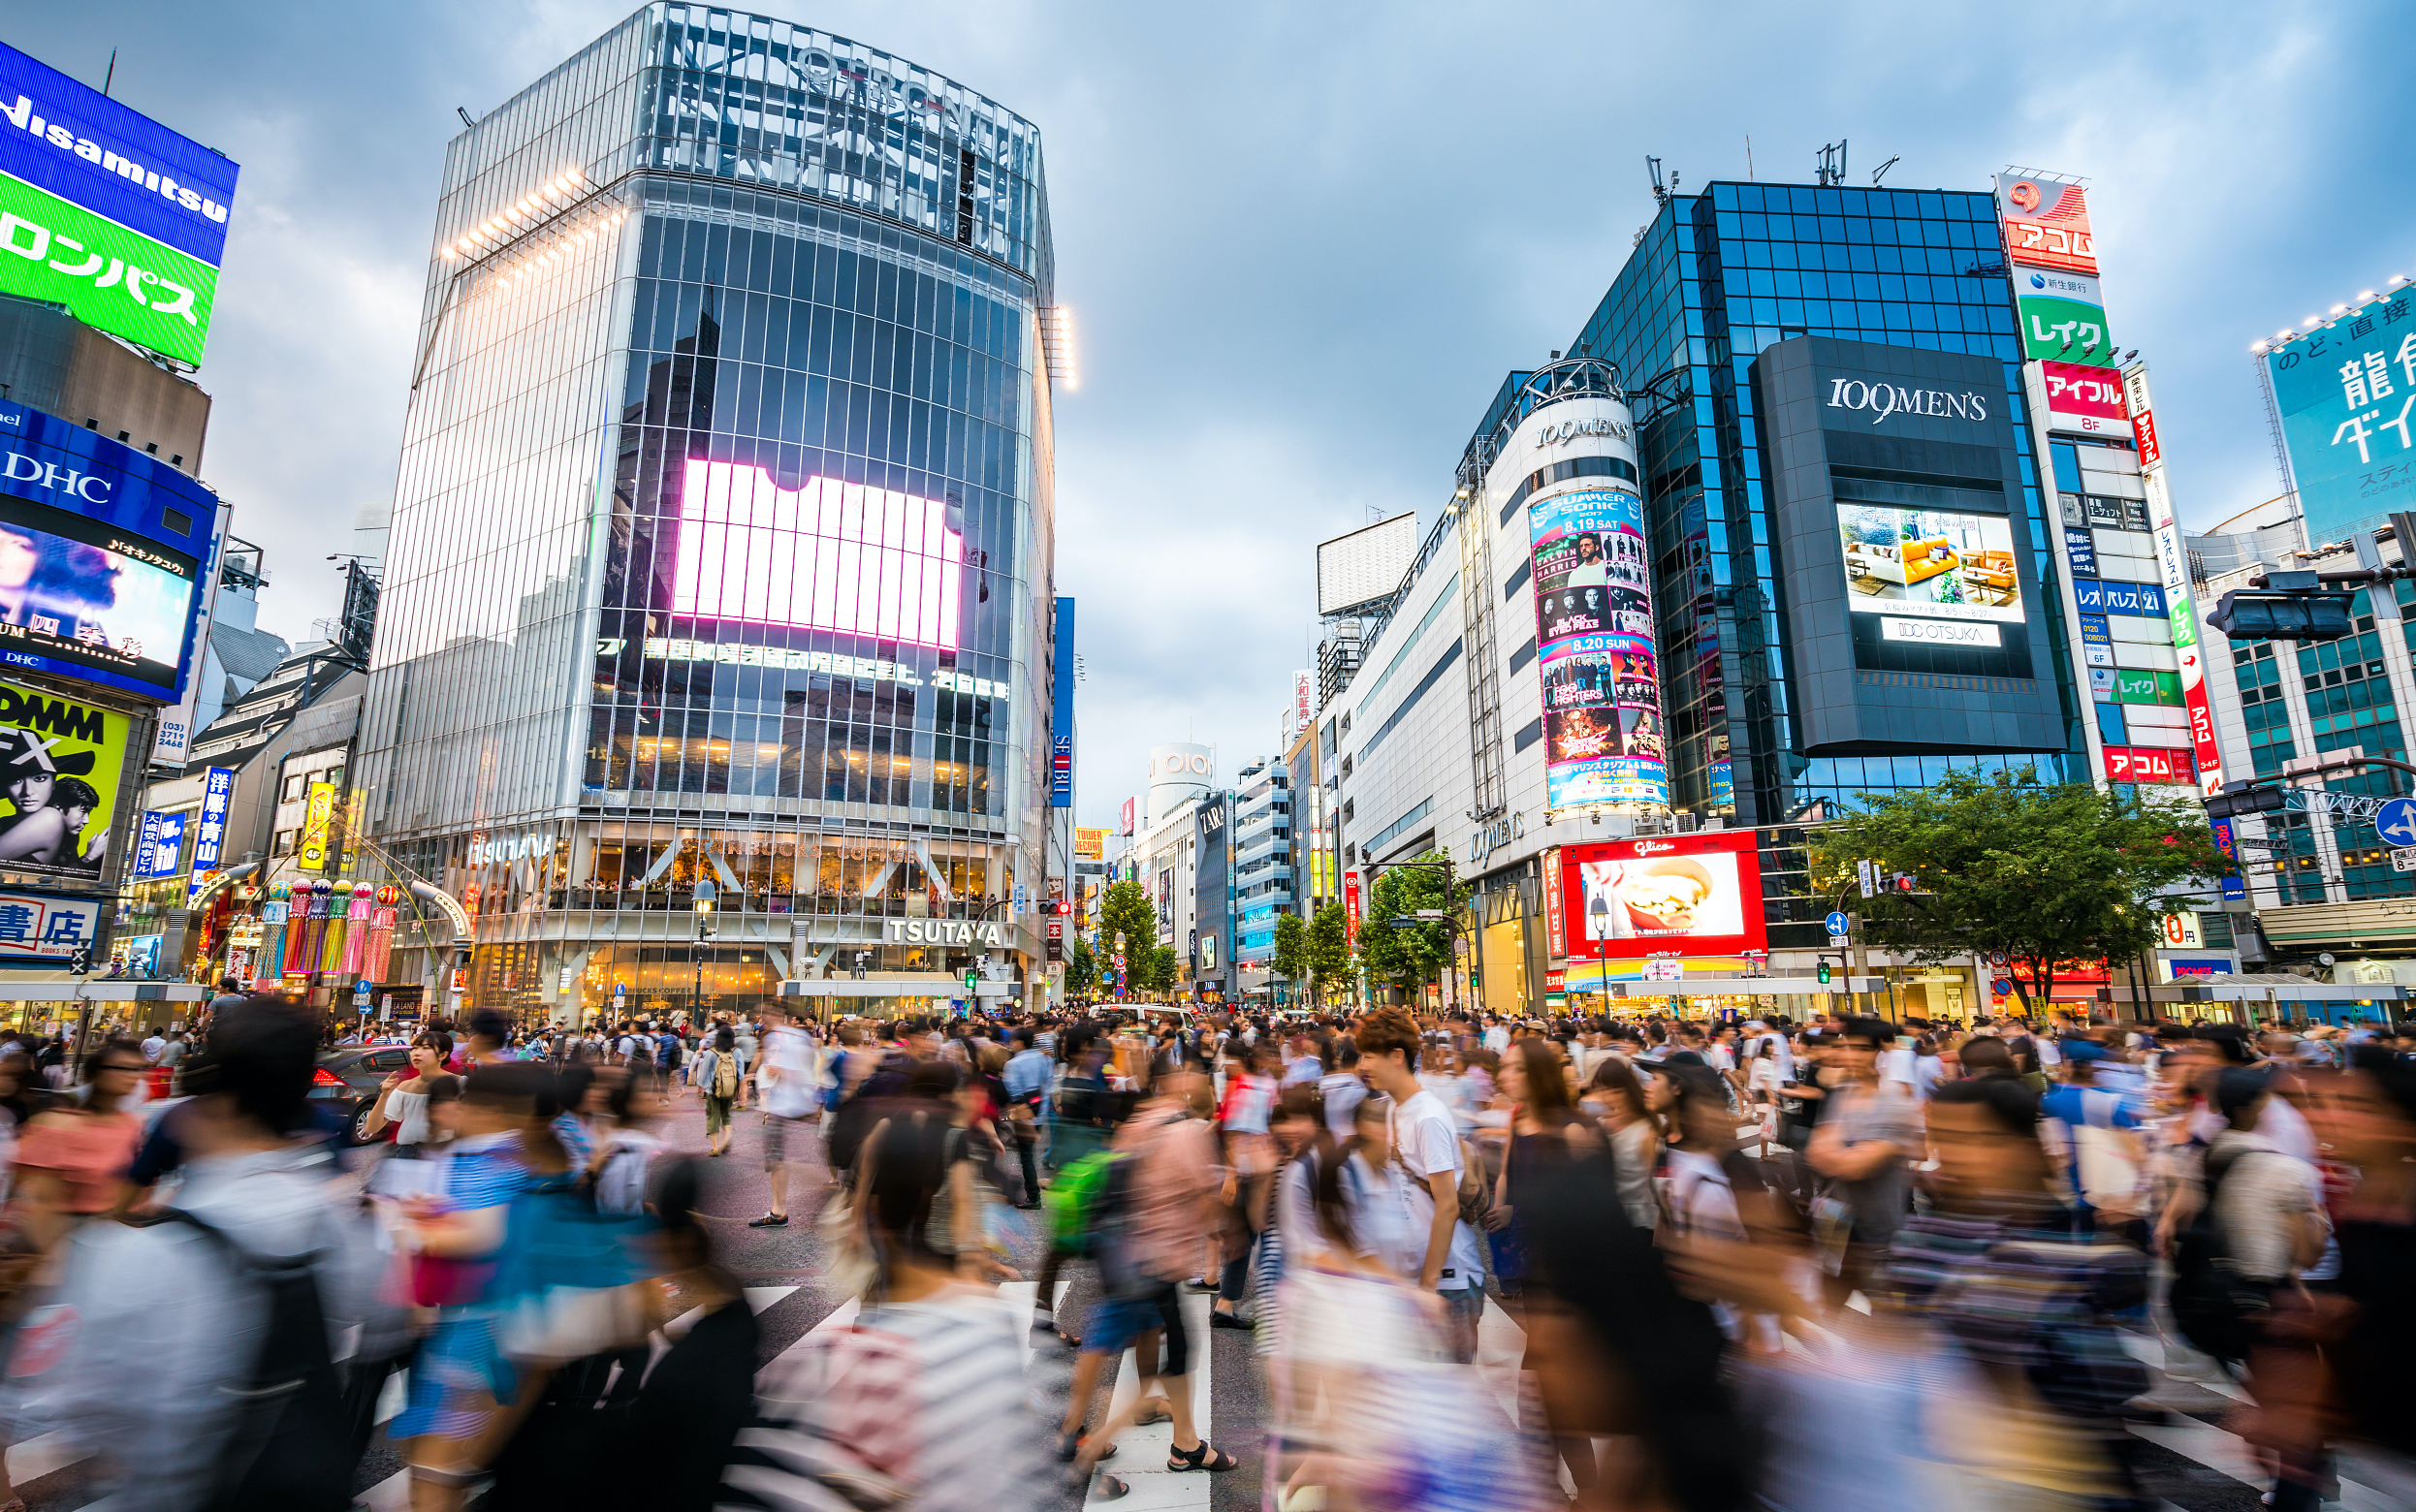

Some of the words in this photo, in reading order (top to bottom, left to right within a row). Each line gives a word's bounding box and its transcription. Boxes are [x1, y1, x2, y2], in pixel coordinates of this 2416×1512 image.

[2018, 224, 2096, 258] アコム
[0, 211, 198, 327] ロンパス
[2048, 278, 2086, 294] 新生銀行
[2031, 315, 2102, 346] レイク
[2279, 298, 2412, 370] のど、直接
[2046, 377, 2122, 404] アイフル
[2082, 418, 2100, 431] 8F
[2140, 425, 2157, 463] アイフル
[1, 451, 111, 504] DHC
[1551, 493, 1625, 510] SUMMER
[1561, 502, 1618, 515] SONIC
[2090, 507, 2121, 517] エージェント
[1565, 519, 1595, 532] 8.19
[1597, 520, 1618, 529] SAT
[1537, 548, 1577, 567] CALVIN
[1538, 560, 1577, 579] HARRIS
[1548, 624, 1573, 638] EYED
[1574, 619, 1600, 633] PEAS
[1557, 614, 1587, 627] BLACK
[2174, 610, 2190, 642] レイク
[29, 614, 143, 658] 四季彩
[1926, 625, 1983, 641] OTSUKA
[1573, 637, 1604, 651] 8.20
[1605, 639, 1630, 649] SUN
[5, 652, 40, 667] DHC
[1555, 683, 1577, 695] FOO
[2119, 679, 2154, 694] レイク
[1297, 675, 1310, 719] 大和証券
[1555, 689, 1603, 706] FIGHTERS
[0, 687, 104, 744] DMM
[2192, 707, 2211, 742] アコム
[159, 730, 184, 740] 3719
[163, 721, 184, 732] (03)
[158, 738, 183, 748] 2468
[1054, 736, 1069, 793] SEIBU
[2112, 755, 2169, 773] アコム
[197, 772, 229, 862] 洋服の青山
[1200, 804, 1224, 835] ZARA
[1077, 830, 1101, 840] TOWER
[305, 849, 321, 859] 4F
[681, 837, 823, 858] STARBUCKS
[837, 845, 916, 865] COFFEE
[1635, 841, 1674, 856] Glico
[1549, 871, 1561, 953] 天津甘栗
[889, 921, 1001, 945] TSUTAYA
[1050, 926, 1060, 935] 本
[231, 952, 240, 979] ラーメ
[2176, 967, 2212, 976] PROMISE
